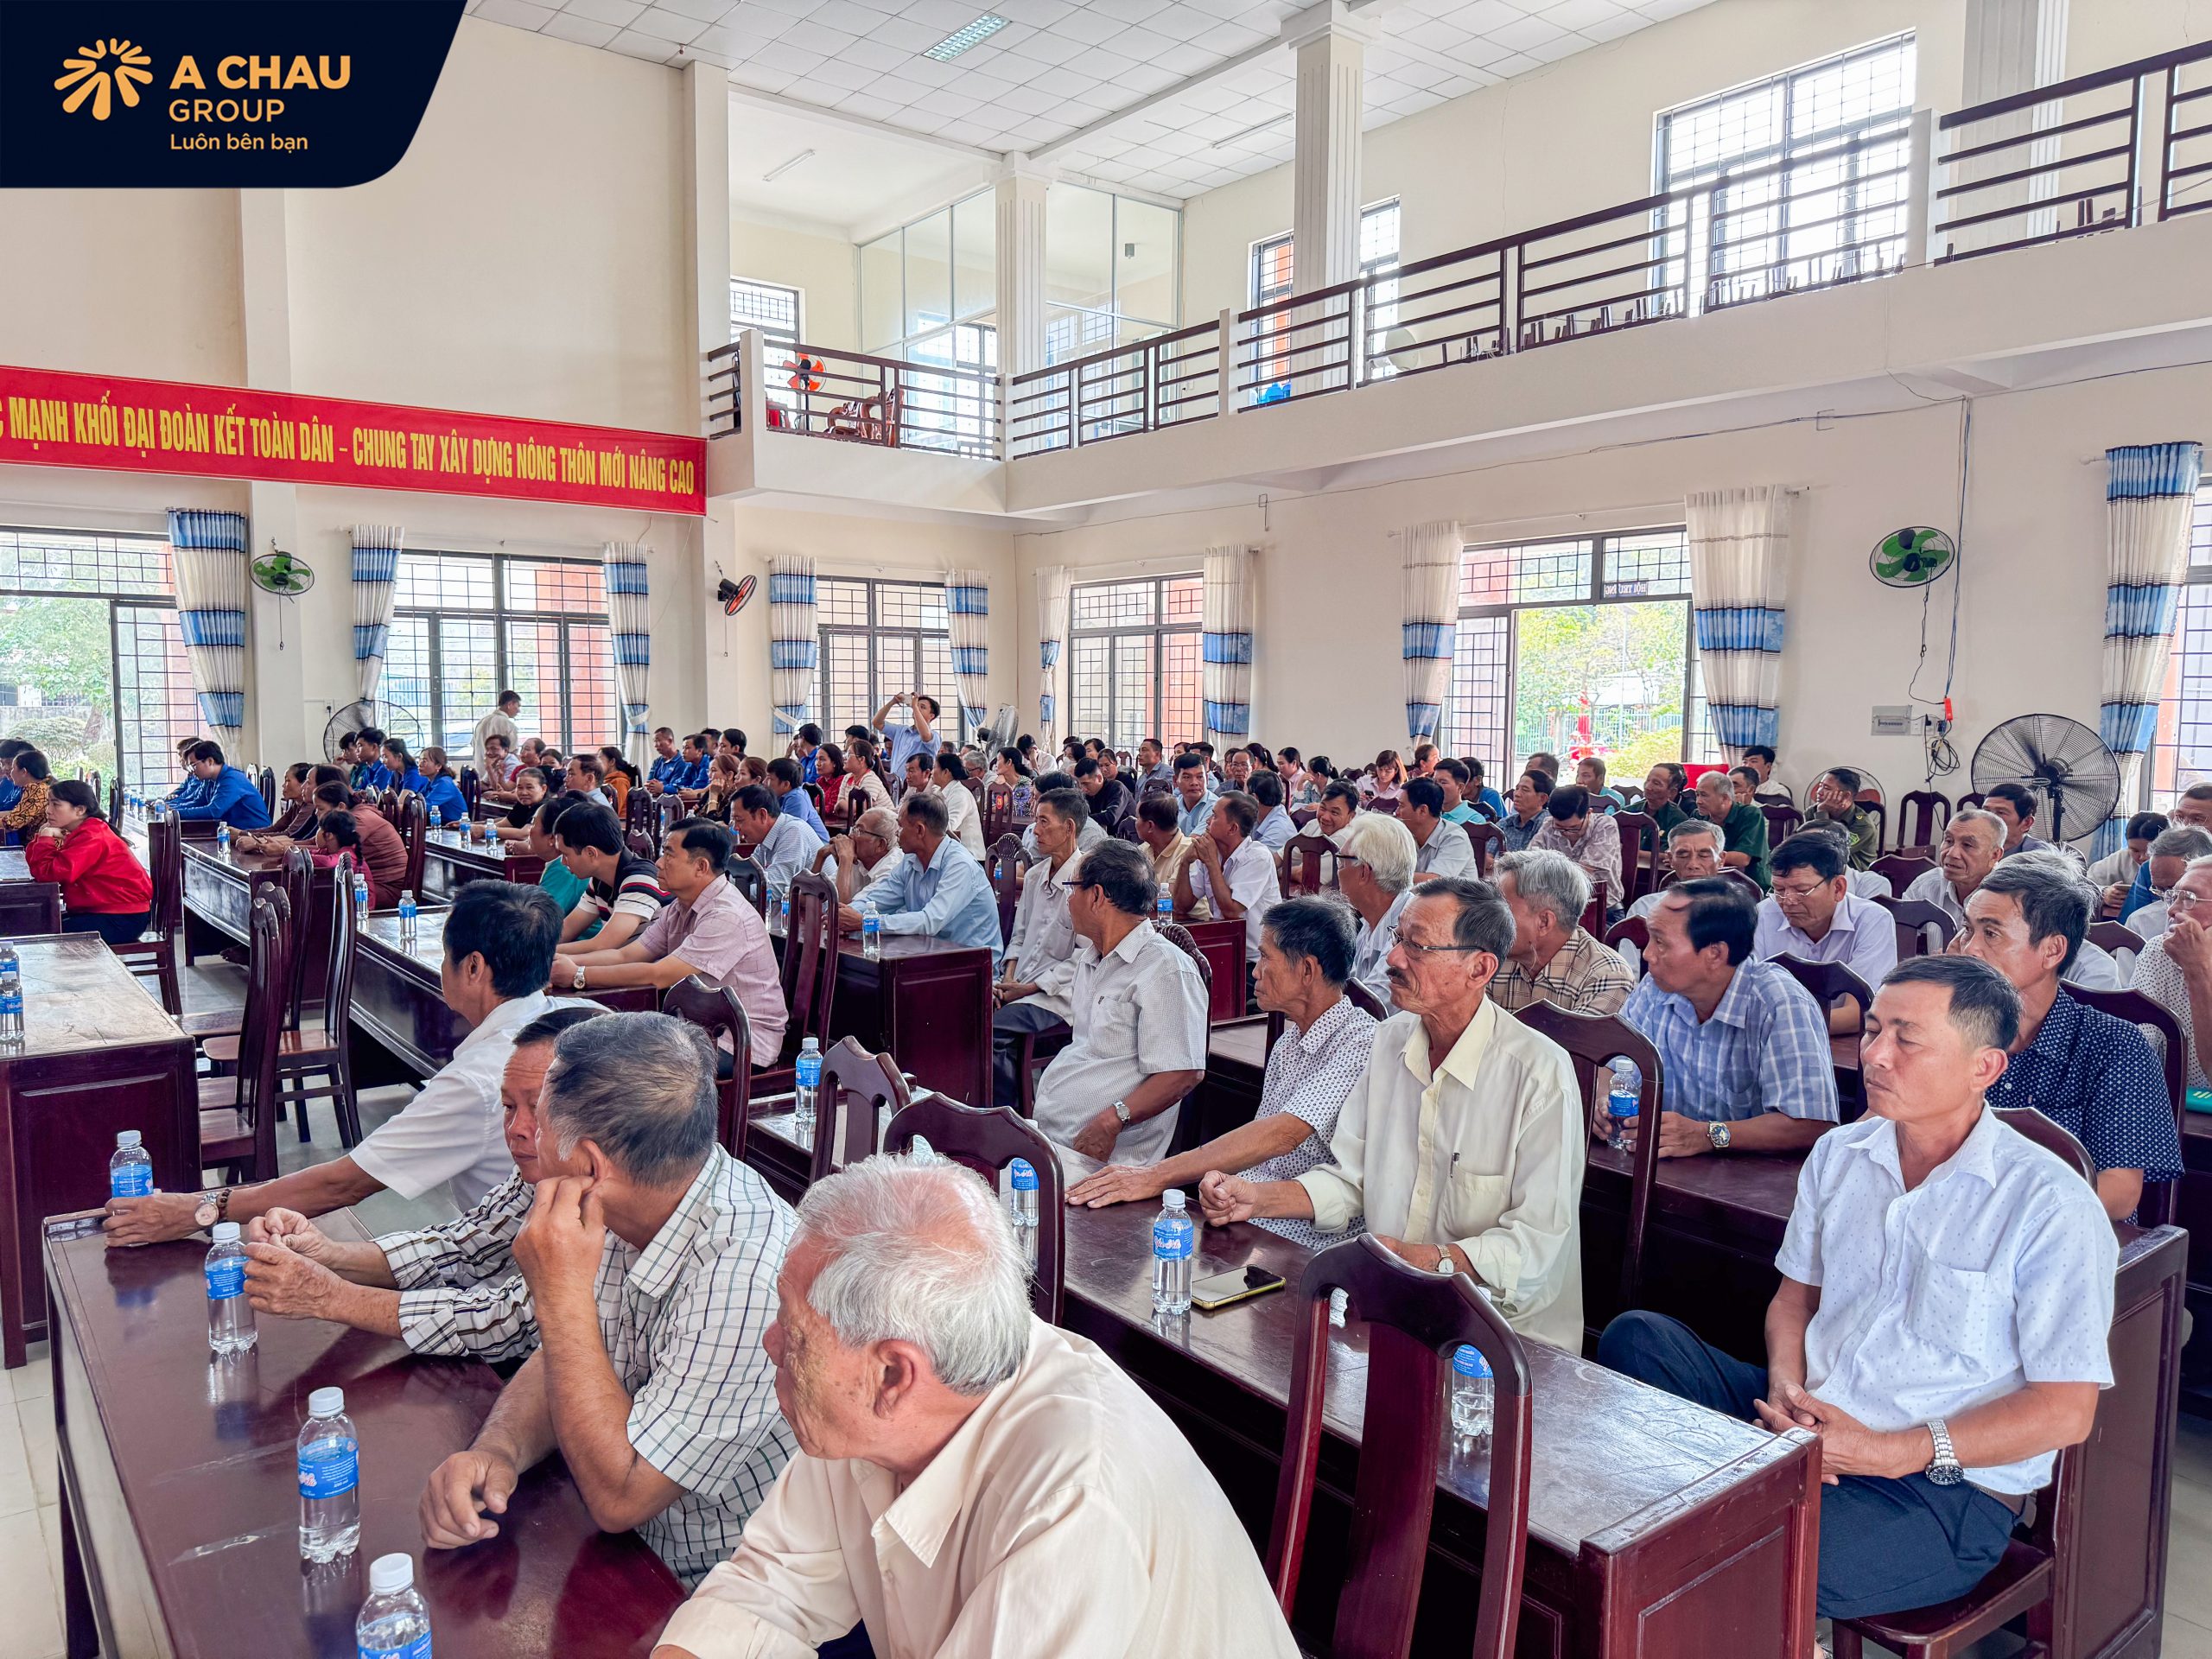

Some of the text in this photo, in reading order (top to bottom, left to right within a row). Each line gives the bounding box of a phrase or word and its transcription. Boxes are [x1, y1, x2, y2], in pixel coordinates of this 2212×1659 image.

[9, 397, 69, 450] MẠNH
[73, 391, 118, 447] KHỐI
[124, 406, 156, 458] ĐẠI
[160, 404, 210, 454] ĐOÀN
[214, 404, 245, 456] KẾT
[251, 411, 296, 461] TOÀN
[300, 416, 334, 463] DÂN
[353, 428, 406, 468] CHUNG
[410, 433, 435, 472] TAY
[439, 429, 468, 474] XÂY
[473, 438, 513, 485] DỰNG
[517, 436, 556, 482] NÔNG
[560, 442, 596, 486] THÔN
[600, 445, 626, 488] MỚI
[629, 449, 666, 493] NÂNG
[670, 460, 694, 495] CAO
